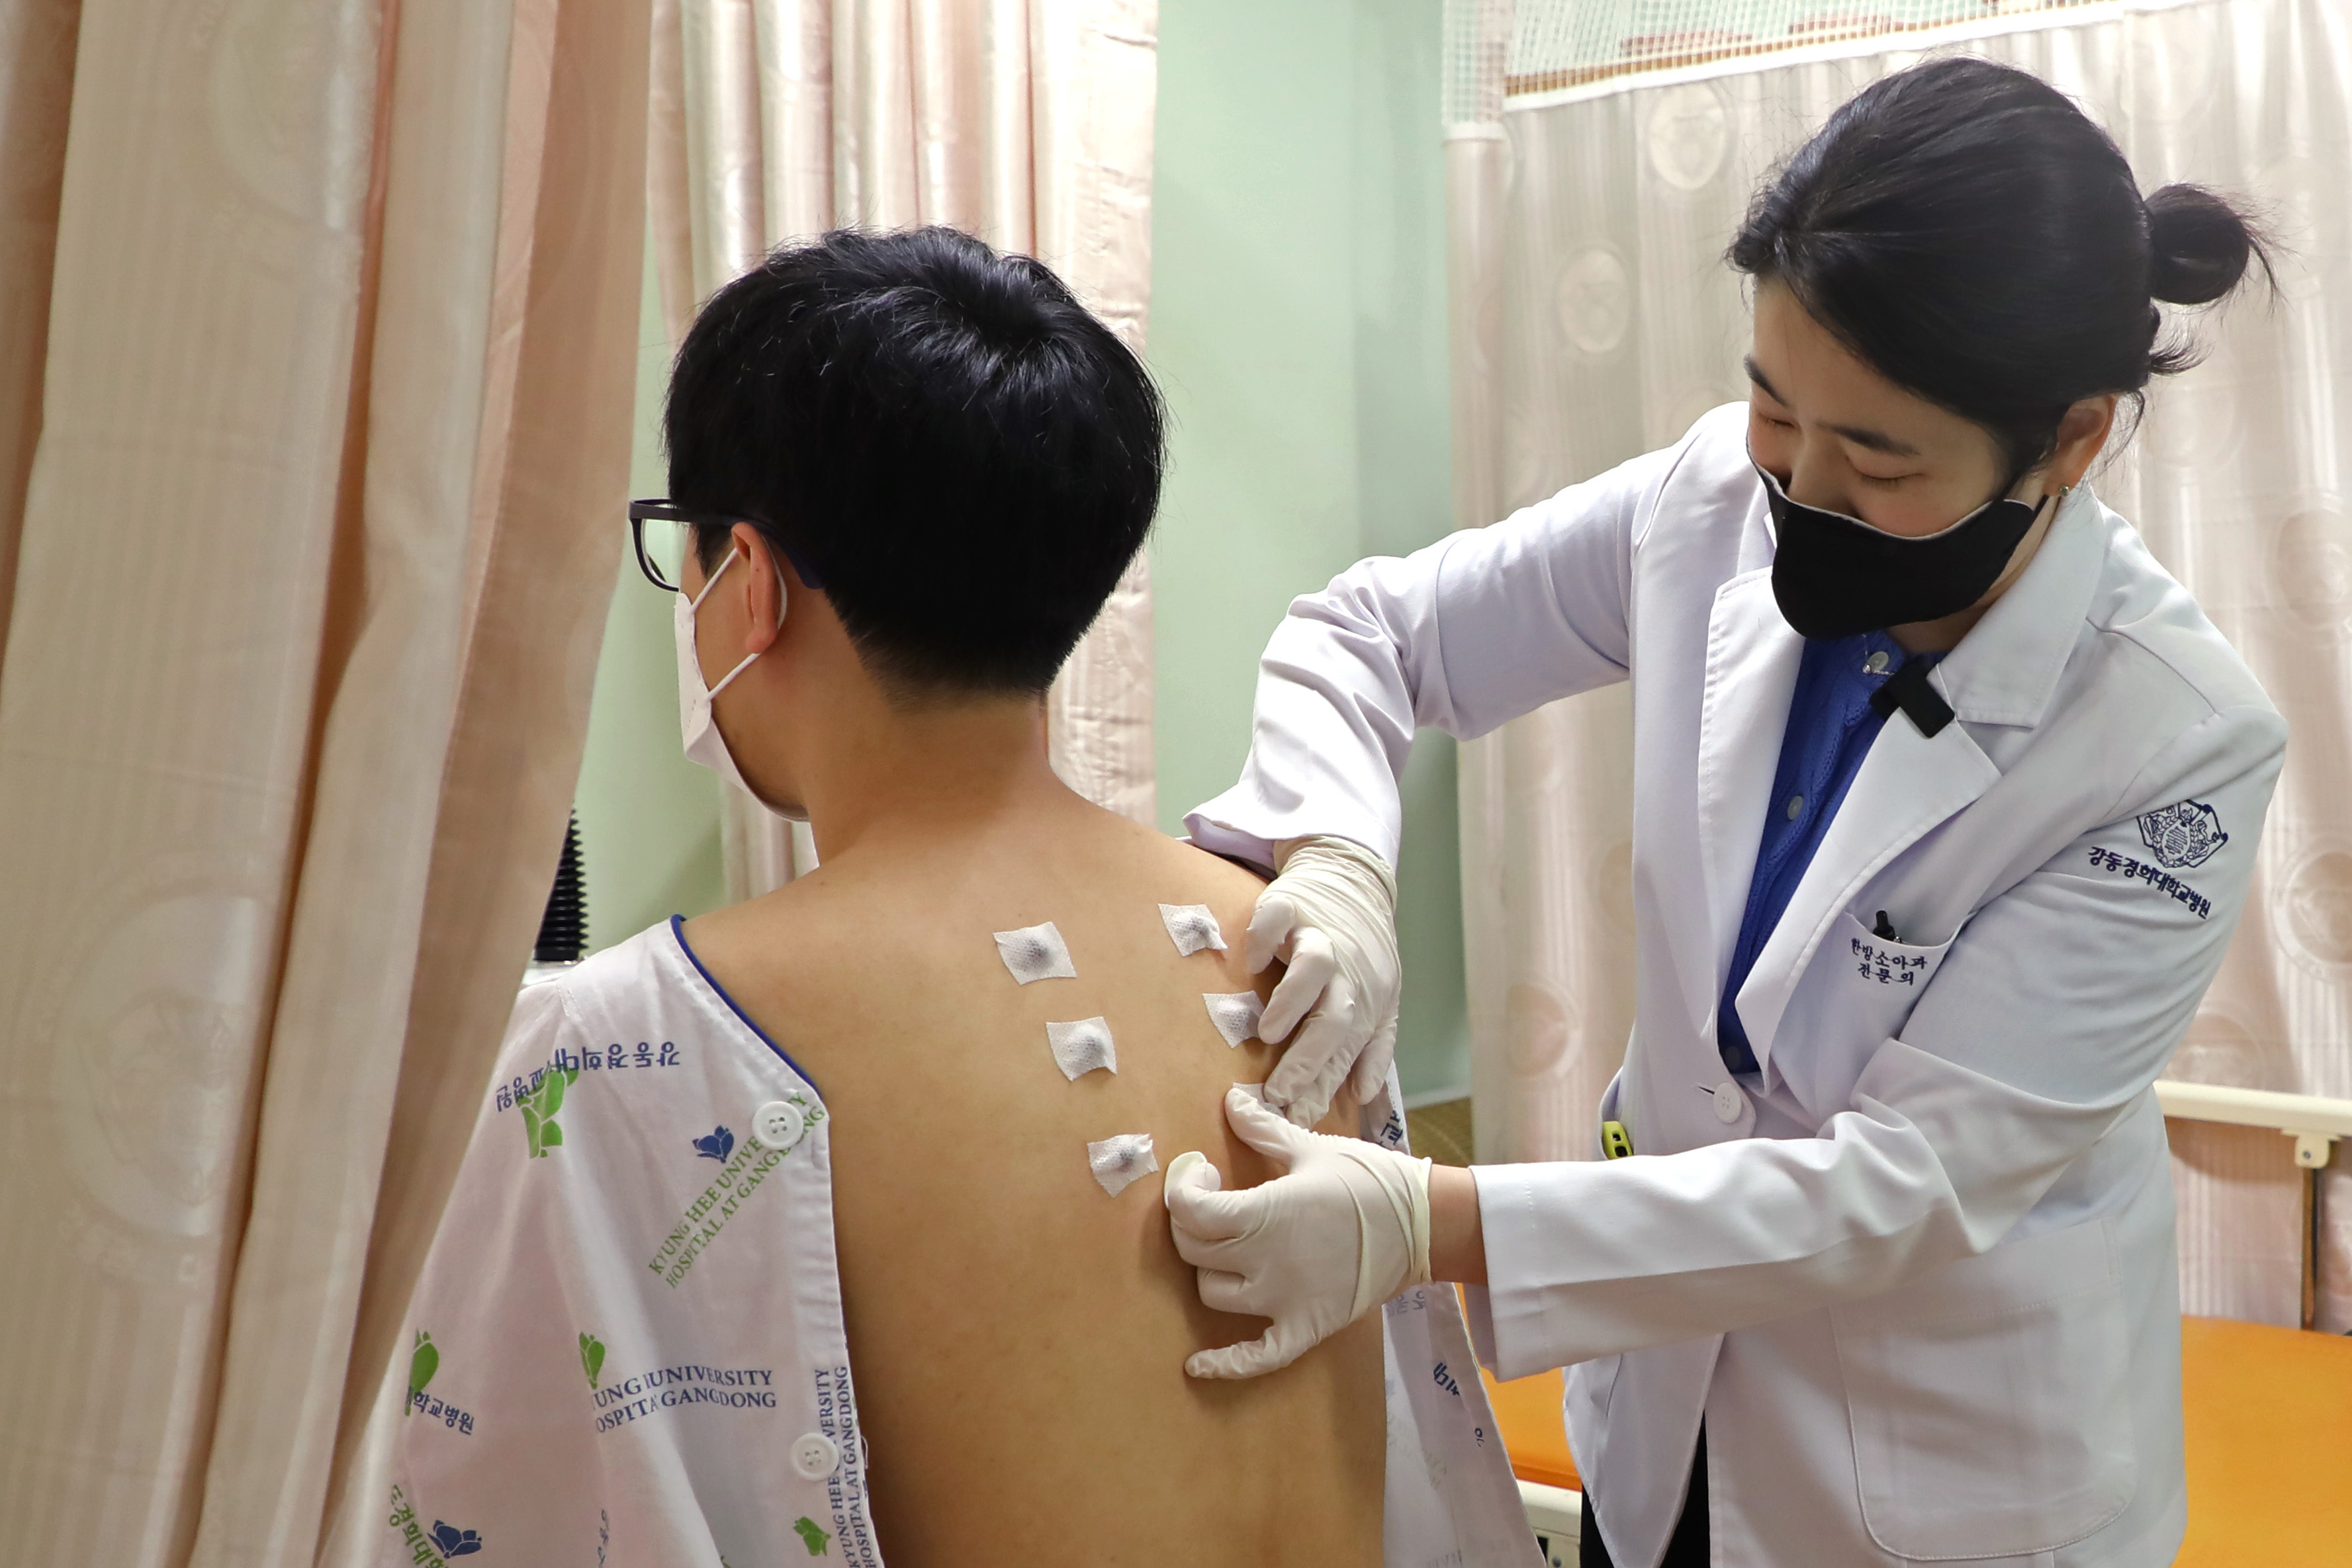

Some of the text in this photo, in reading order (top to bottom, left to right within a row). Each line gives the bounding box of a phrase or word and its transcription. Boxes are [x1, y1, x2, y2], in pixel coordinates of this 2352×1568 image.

[2088, 846, 2211, 920] 강동경희대학교병원
[1858, 962, 1914, 986] 전문의
[496, 1041, 680, 1112] 강동경희대교병원
[649, 1092, 807, 1275] KYUNG HEE UNIVEY
[666, 1106, 826, 1289] HOSPITAL AT GANGNG
[405, 1385, 475, 1436] 학교병원
[593, 1377, 642, 1410] UNG
[649, 1365, 772, 1387] UNIVERSITY
[596, 1394, 658, 1433] OSPITA
[815, 1369, 861, 1568] KYUNG HEE VERSITY
[835, 1366, 877, 1568] HOSPITAL AT GANGDONG
